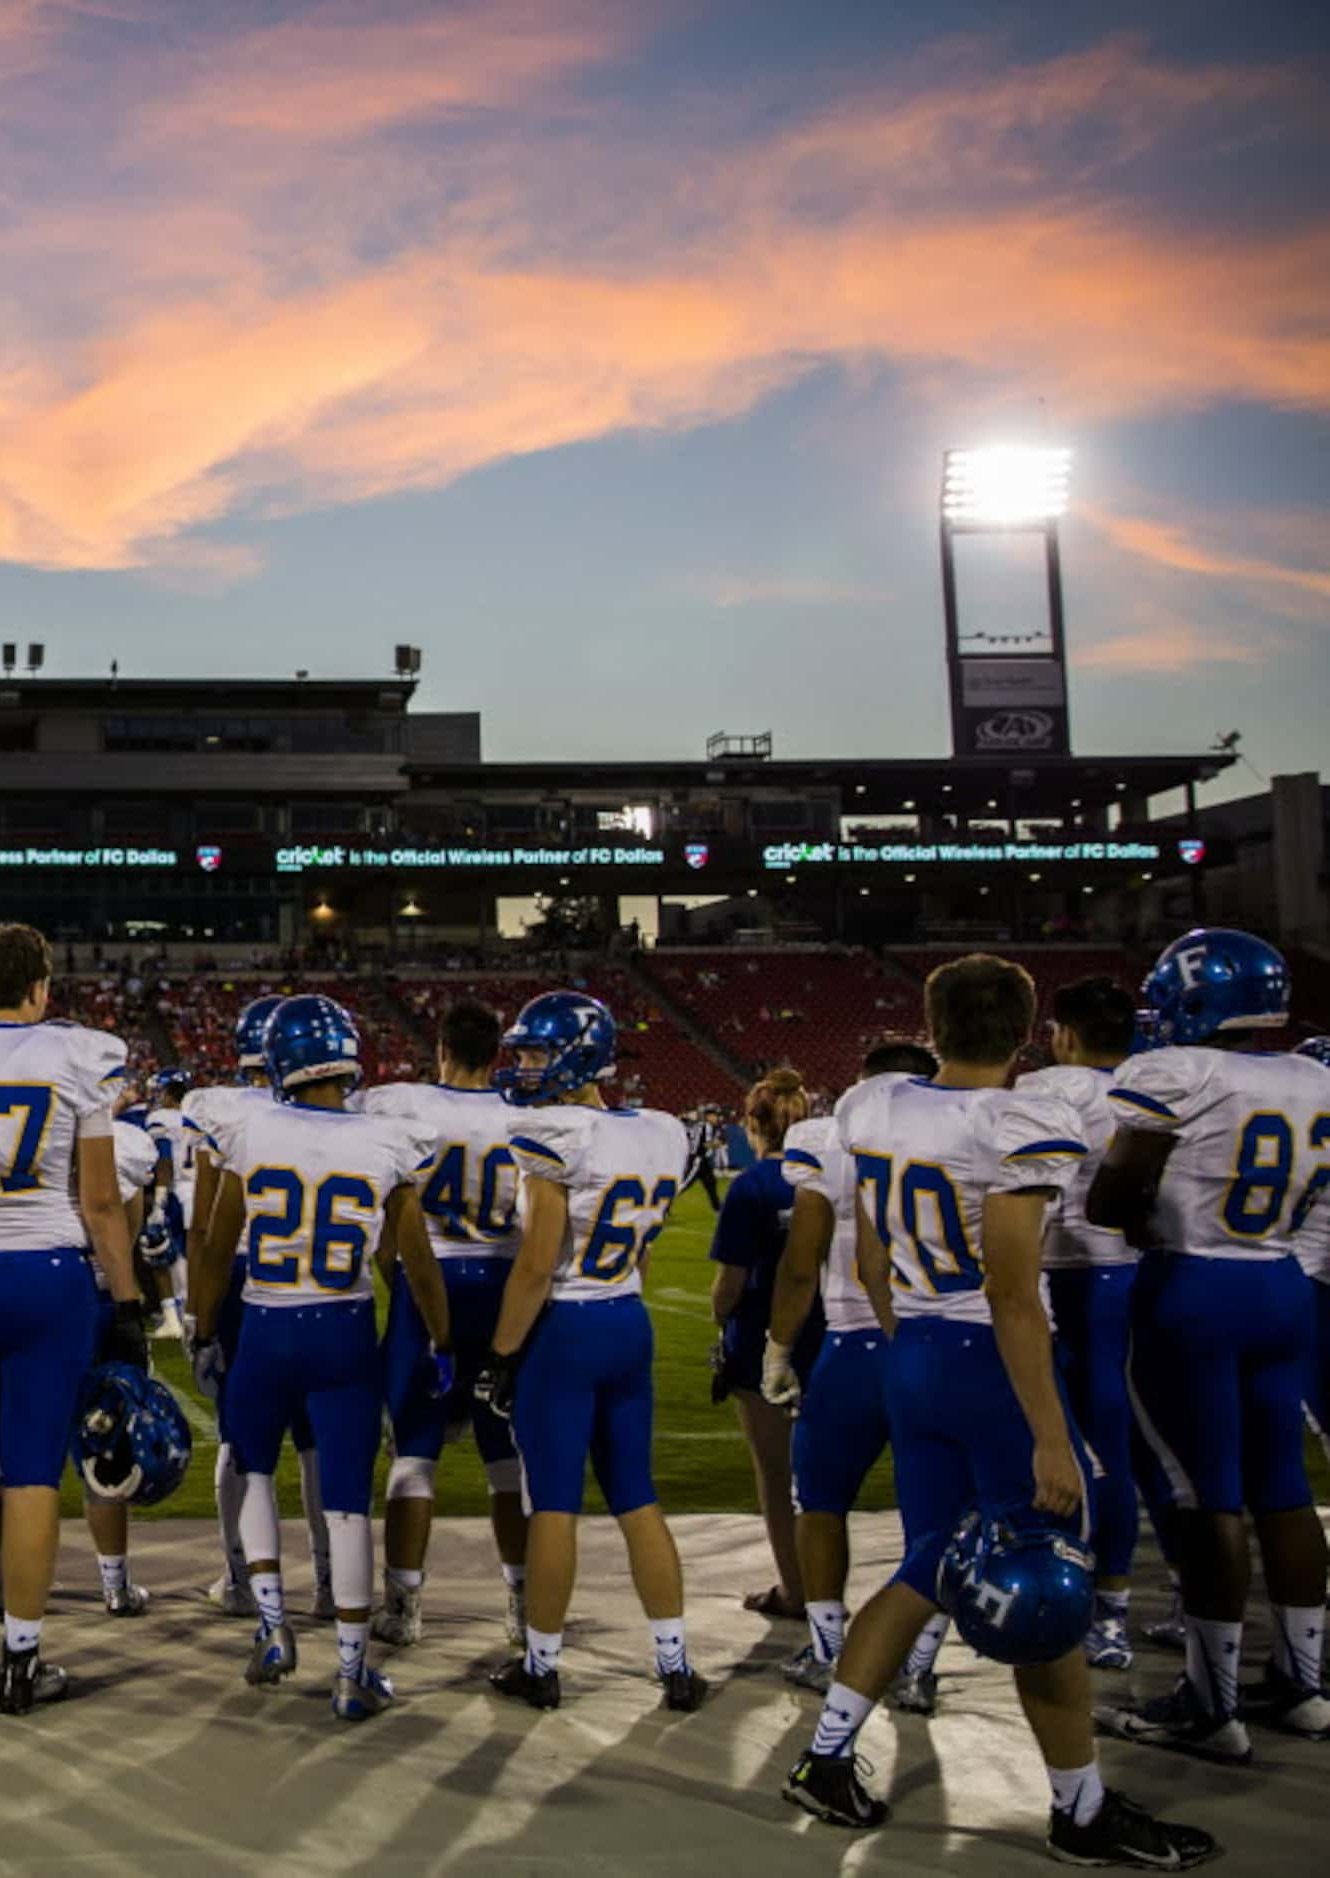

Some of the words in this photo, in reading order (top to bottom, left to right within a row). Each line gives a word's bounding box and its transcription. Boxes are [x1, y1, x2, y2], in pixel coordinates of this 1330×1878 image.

[25, 849, 83, 865] Partner
[84, 849, 102, 865] of
[102, 849, 125, 865] FC
[125, 849, 177, 865] Dallas
[349, 850, 362, 865] is
[362, 850, 389, 865] the
[389, 849, 447, 865] Official
[448, 849, 512, 865] Wireless
[512, 849, 570, 864] Partner
[571, 849, 589, 864] of
[589, 848, 612, 864] FC
[613, 848, 664, 864] Dallas
[838, 845, 851, 861] is
[852, 845, 878, 861] the
[878, 845, 938, 860] Official
[938, 845, 1003, 860] Wireless
[1003, 844, 1063, 860] Partner
[1064, 844, 1082, 860] of
[1082, 844, 1106, 859] FC
[1106, 844, 1159, 859] Dallas
[1175, 943, 1208, 991] F
[421, 1141, 519, 1243] 40
[244, 1165, 376, 1293] 26
[850, 1145, 987, 1296] 70
